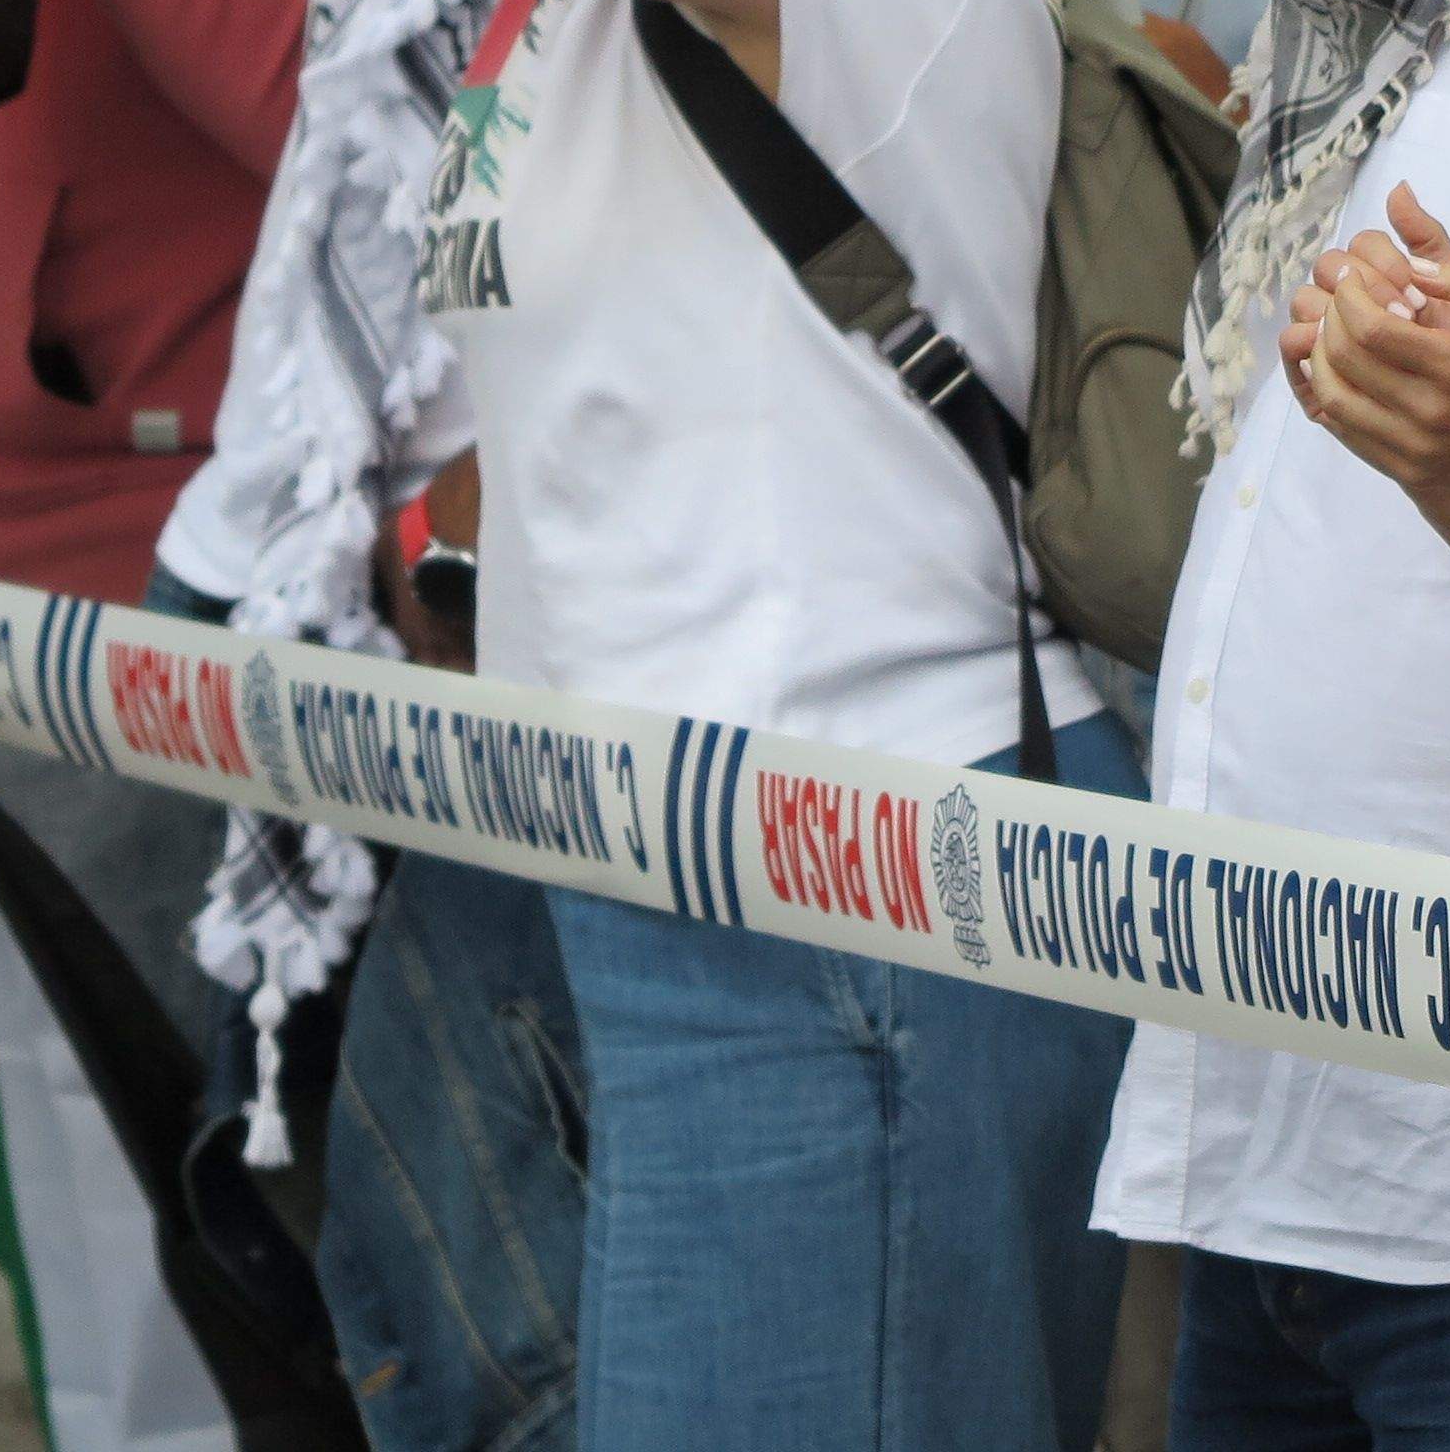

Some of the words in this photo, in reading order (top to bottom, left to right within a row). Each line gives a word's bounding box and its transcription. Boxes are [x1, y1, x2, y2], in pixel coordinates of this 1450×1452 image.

[105, 641, 208, 770] PASAR
[196, 658, 254, 778] NO
[289, 679, 416, 818] POLICIA
[407, 702, 459, 828] DE
[452, 712, 612, 863] NACIONAL
[605, 741, 648, 873] C.
[757, 770, 875, 921] PASAR
[874, 791, 932, 934] NO
[995, 818, 1146, 983] POLICIA
[1149, 847, 1204, 996] DE
[1206, 857, 1405, 1039] NACIONAL
